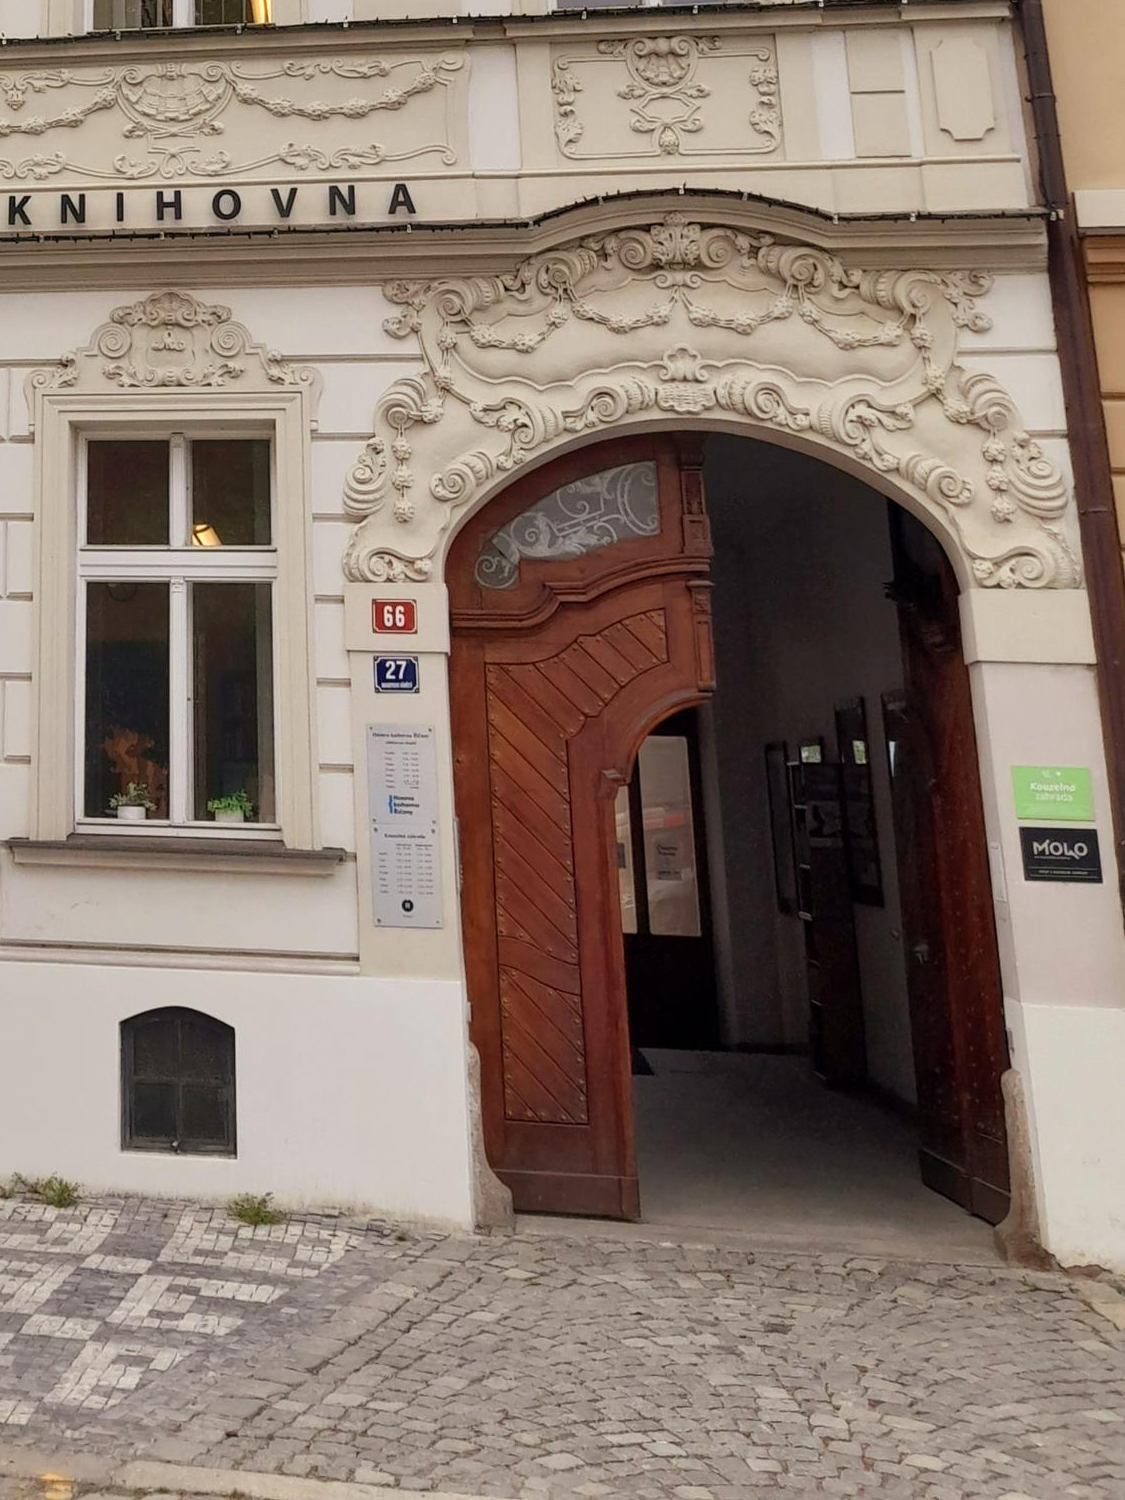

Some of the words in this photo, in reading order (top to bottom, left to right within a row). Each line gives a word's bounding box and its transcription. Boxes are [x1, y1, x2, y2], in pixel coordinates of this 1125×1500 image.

[8, 183, 417, 226] KNIHOVNA
[383, 605, 405, 627] 66
[385, 660, 407, 680] 27
[1032, 839, 1088, 860] MOLO
